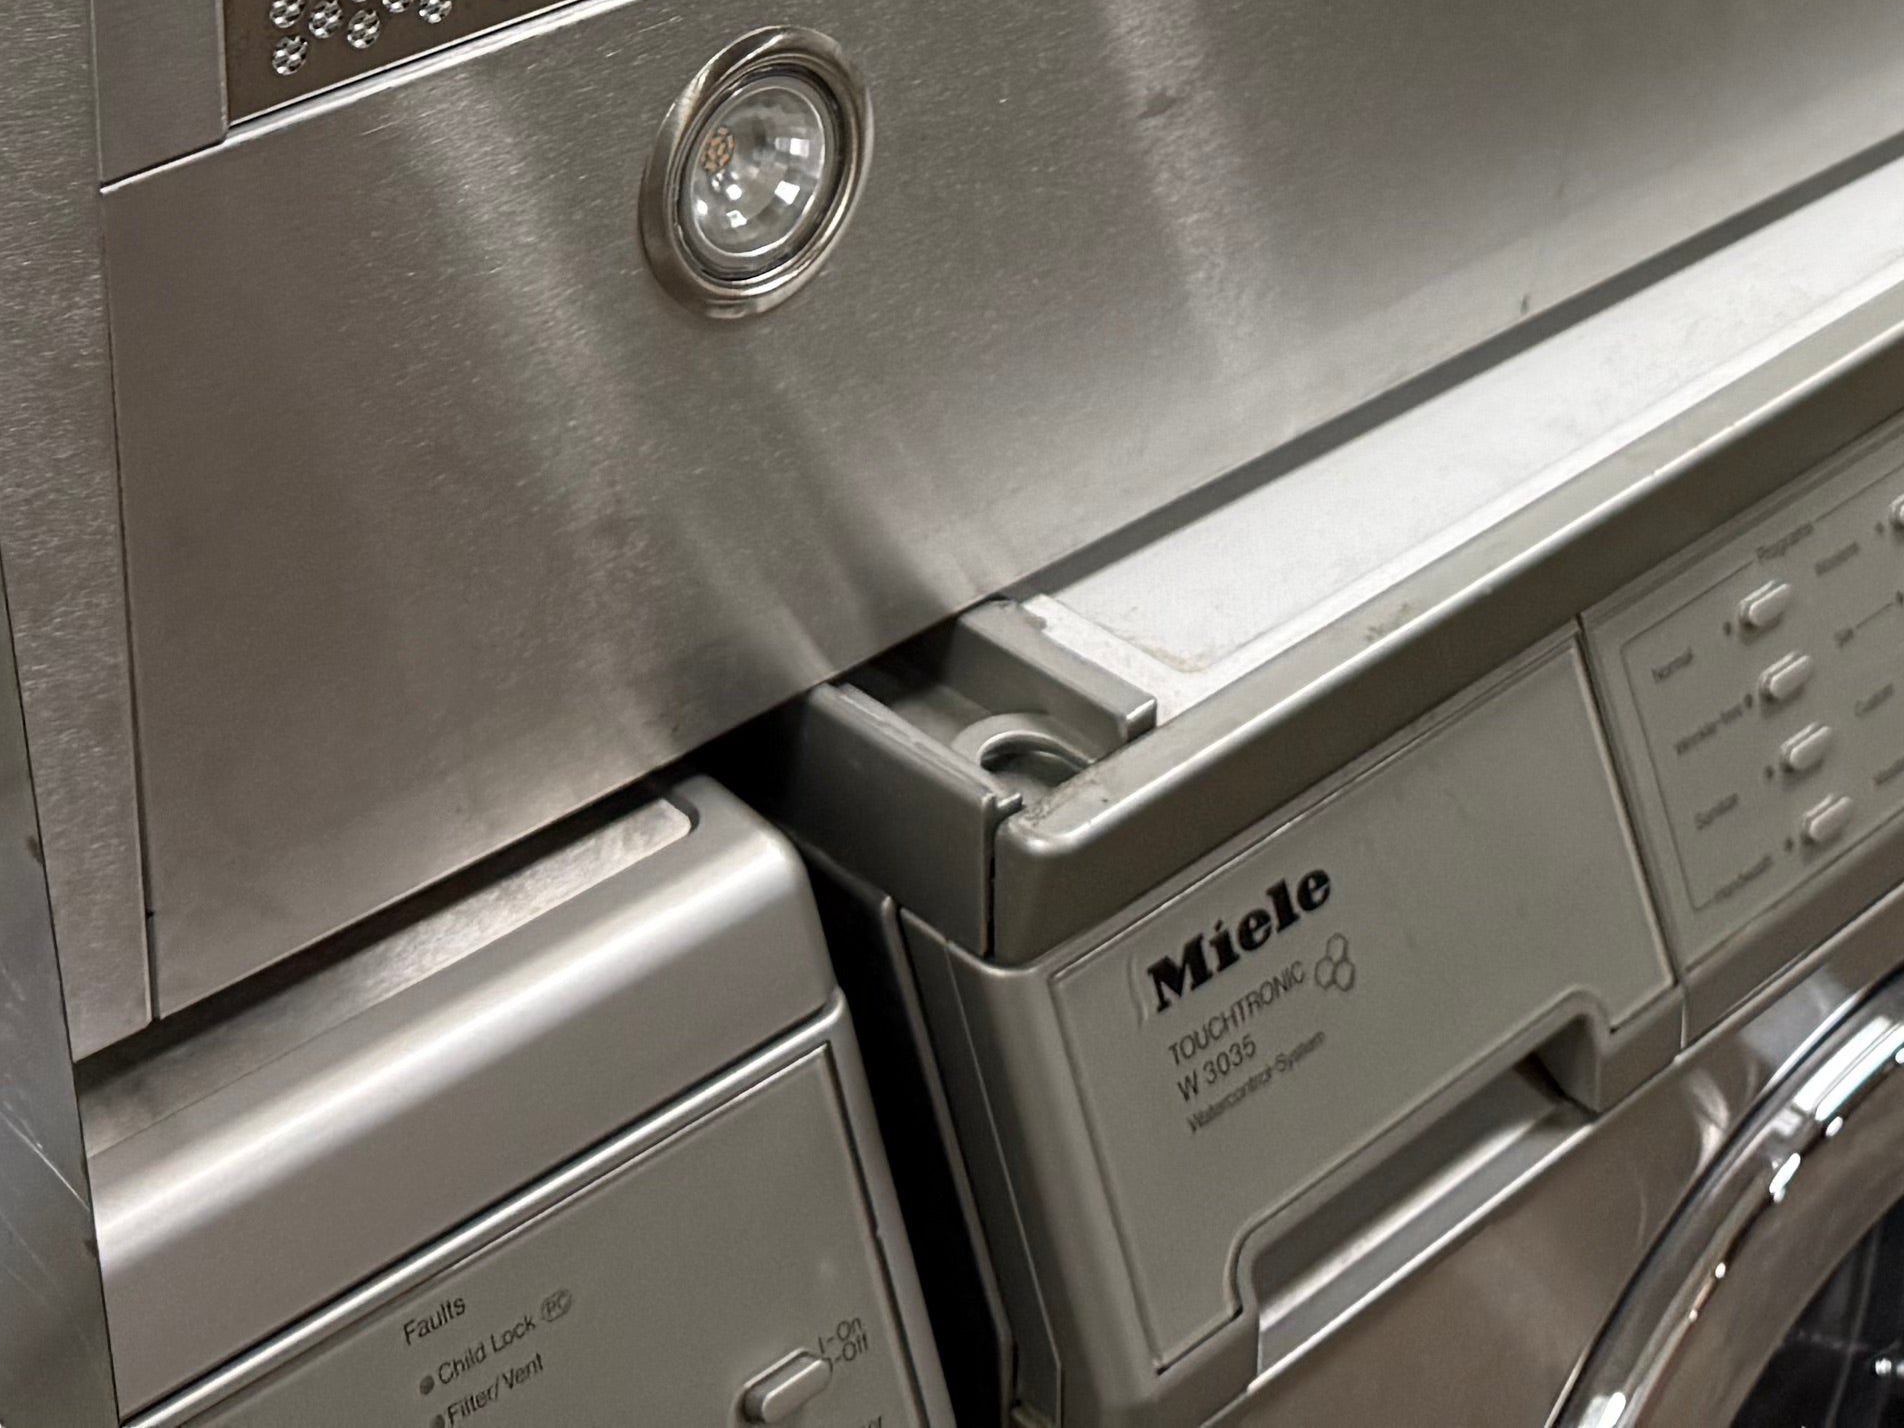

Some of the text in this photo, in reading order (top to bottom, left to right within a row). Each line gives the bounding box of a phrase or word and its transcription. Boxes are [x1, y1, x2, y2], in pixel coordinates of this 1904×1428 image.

[1146, 869, 1332, 1013] Miele
[1168, 960, 1306, 1066] TOUCHTRONIC
[1177, 1034, 1257, 1102] W 3035
[403, 1297, 467, 1345] Faults
[438, 1341, 487, 1384] Child
[490, 1315, 537, 1352] Lock
